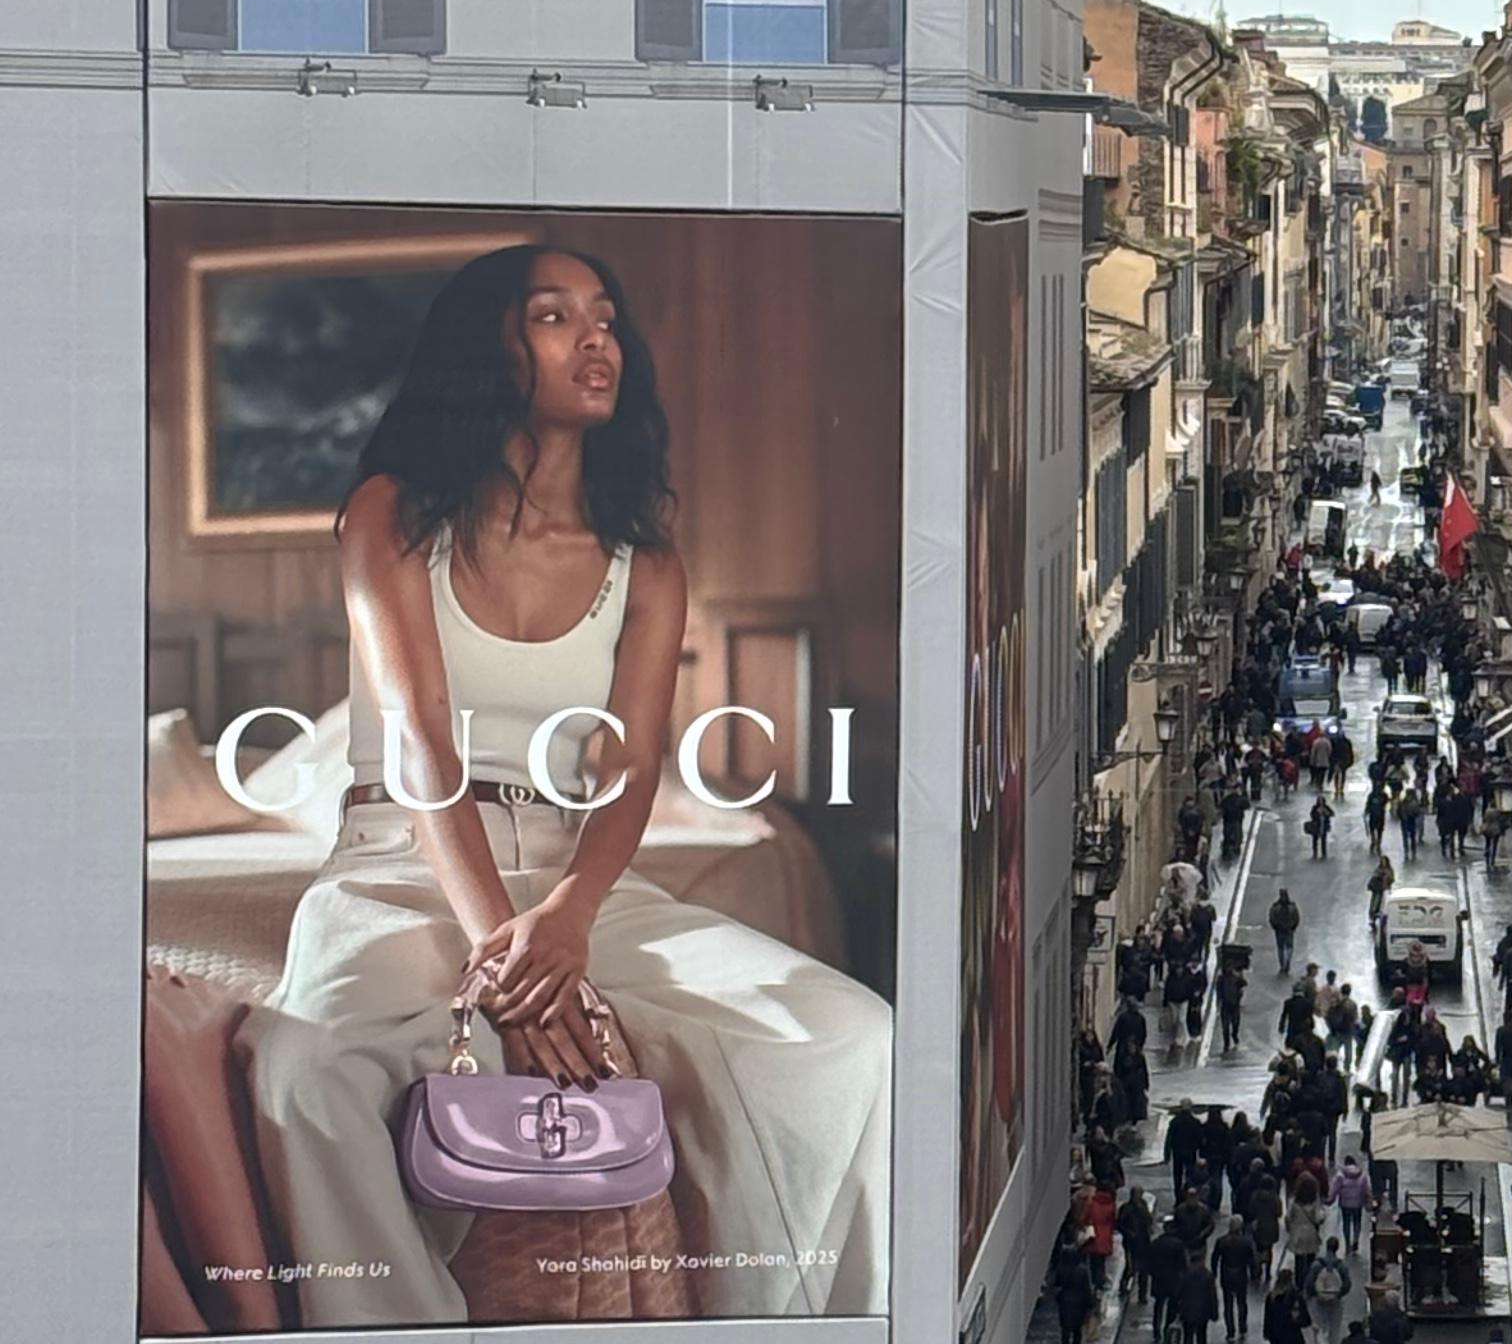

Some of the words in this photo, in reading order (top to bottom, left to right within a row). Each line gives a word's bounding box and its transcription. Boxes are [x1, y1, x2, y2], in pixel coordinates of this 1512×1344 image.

[215, 706, 853, 812] GUCCI
[204, 1265, 262, 1281] Where
[267, 1263, 312, 1283] Light
[317, 1262, 364, 1278] Finds
[369, 1260, 391, 1277] Us
[536, 1258, 577, 1273] Yara
[581, 1254, 647, 1272] Shahidi
[650, 1253, 672, 1274] by
[675, 1253, 731, 1269] Xavier
[735, 1251, 791, 1269] Dolan,
[796, 1250, 838, 1266] 2025
